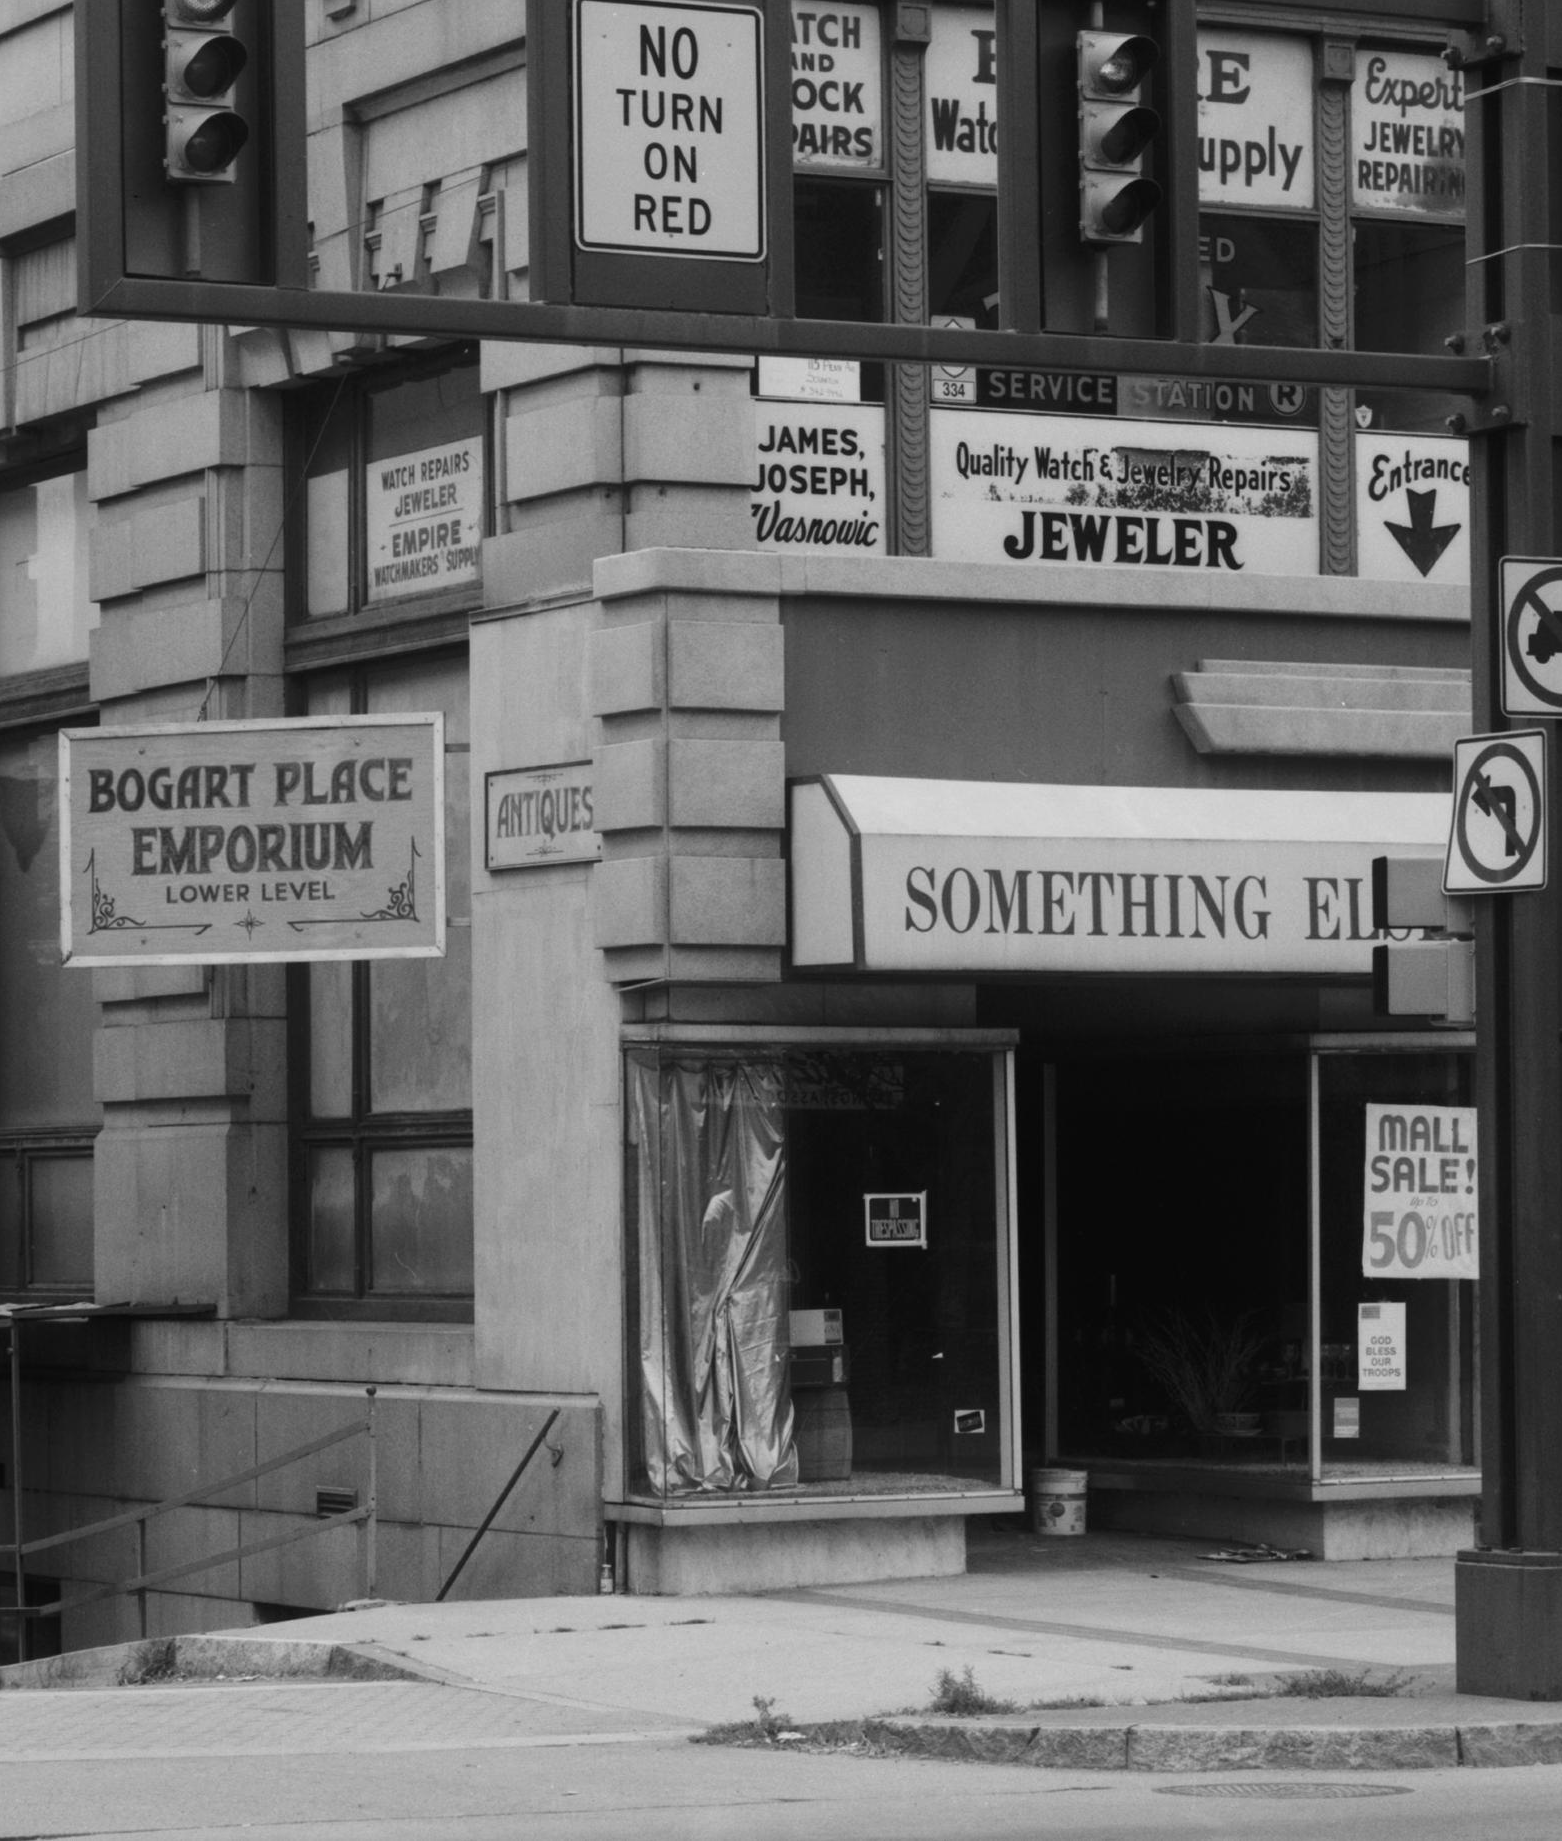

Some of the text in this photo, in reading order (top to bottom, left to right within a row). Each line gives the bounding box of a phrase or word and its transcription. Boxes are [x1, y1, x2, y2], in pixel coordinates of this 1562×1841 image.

[792, 12, 861, 49] TCH
[638, 24, 698, 80] NO
[792, 78, 865, 114] OCK
[1365, 56, 1465, 119] Expert
[616, 88, 724, 135] TURN
[644, 144, 697, 184] ON
[1198, 125, 1303, 191] upply
[1358, 159, 1465, 198] REPAIRIN
[635, 194, 712, 237] RED
[942, 382, 966, 398] 334
[989, 373, 1113, 404] SERVICE
[1133, 378, 1254, 411] STATION
[758, 425, 865, 461] JAMES,
[381, 450, 470, 491] WATCH REPAIRS
[750, 464, 875, 501] JOSEPH,
[956, 441, 1029, 485] Quality
[1035, 446, 1094, 482] Watch
[1116, 454, 1202, 492] Jewelry
[1208, 456, 1292, 498] Repairs
[1368, 450, 1470, 501] Entrance
[395, 482, 458, 518] JEWELER
[392, 519, 462, 558] EMPIRE
[1004, 511, 1245, 570] JEWELER
[87, 757, 413, 814] BOGART PLACE
[496, 785, 594, 841] ANTIQUES
[131, 820, 374, 877] EMPORIUM
[166, 881, 335, 904] LOWER LEVEL
[905, 865, 1454, 942] SOMETHING EL
[1379, 1114, 1468, 1154] MALL
[1370, 1155, 1476, 1195] SALE!
[1370, 1211, 1476, 1269] 50% OFF
[1365, 1346, 1397, 1356] BLESS
[1370, 1336, 1392, 1345] GOD
[1363, 1368, 1402, 1377] TROOPS
[1371, 1357, 1392, 1367] OUR
